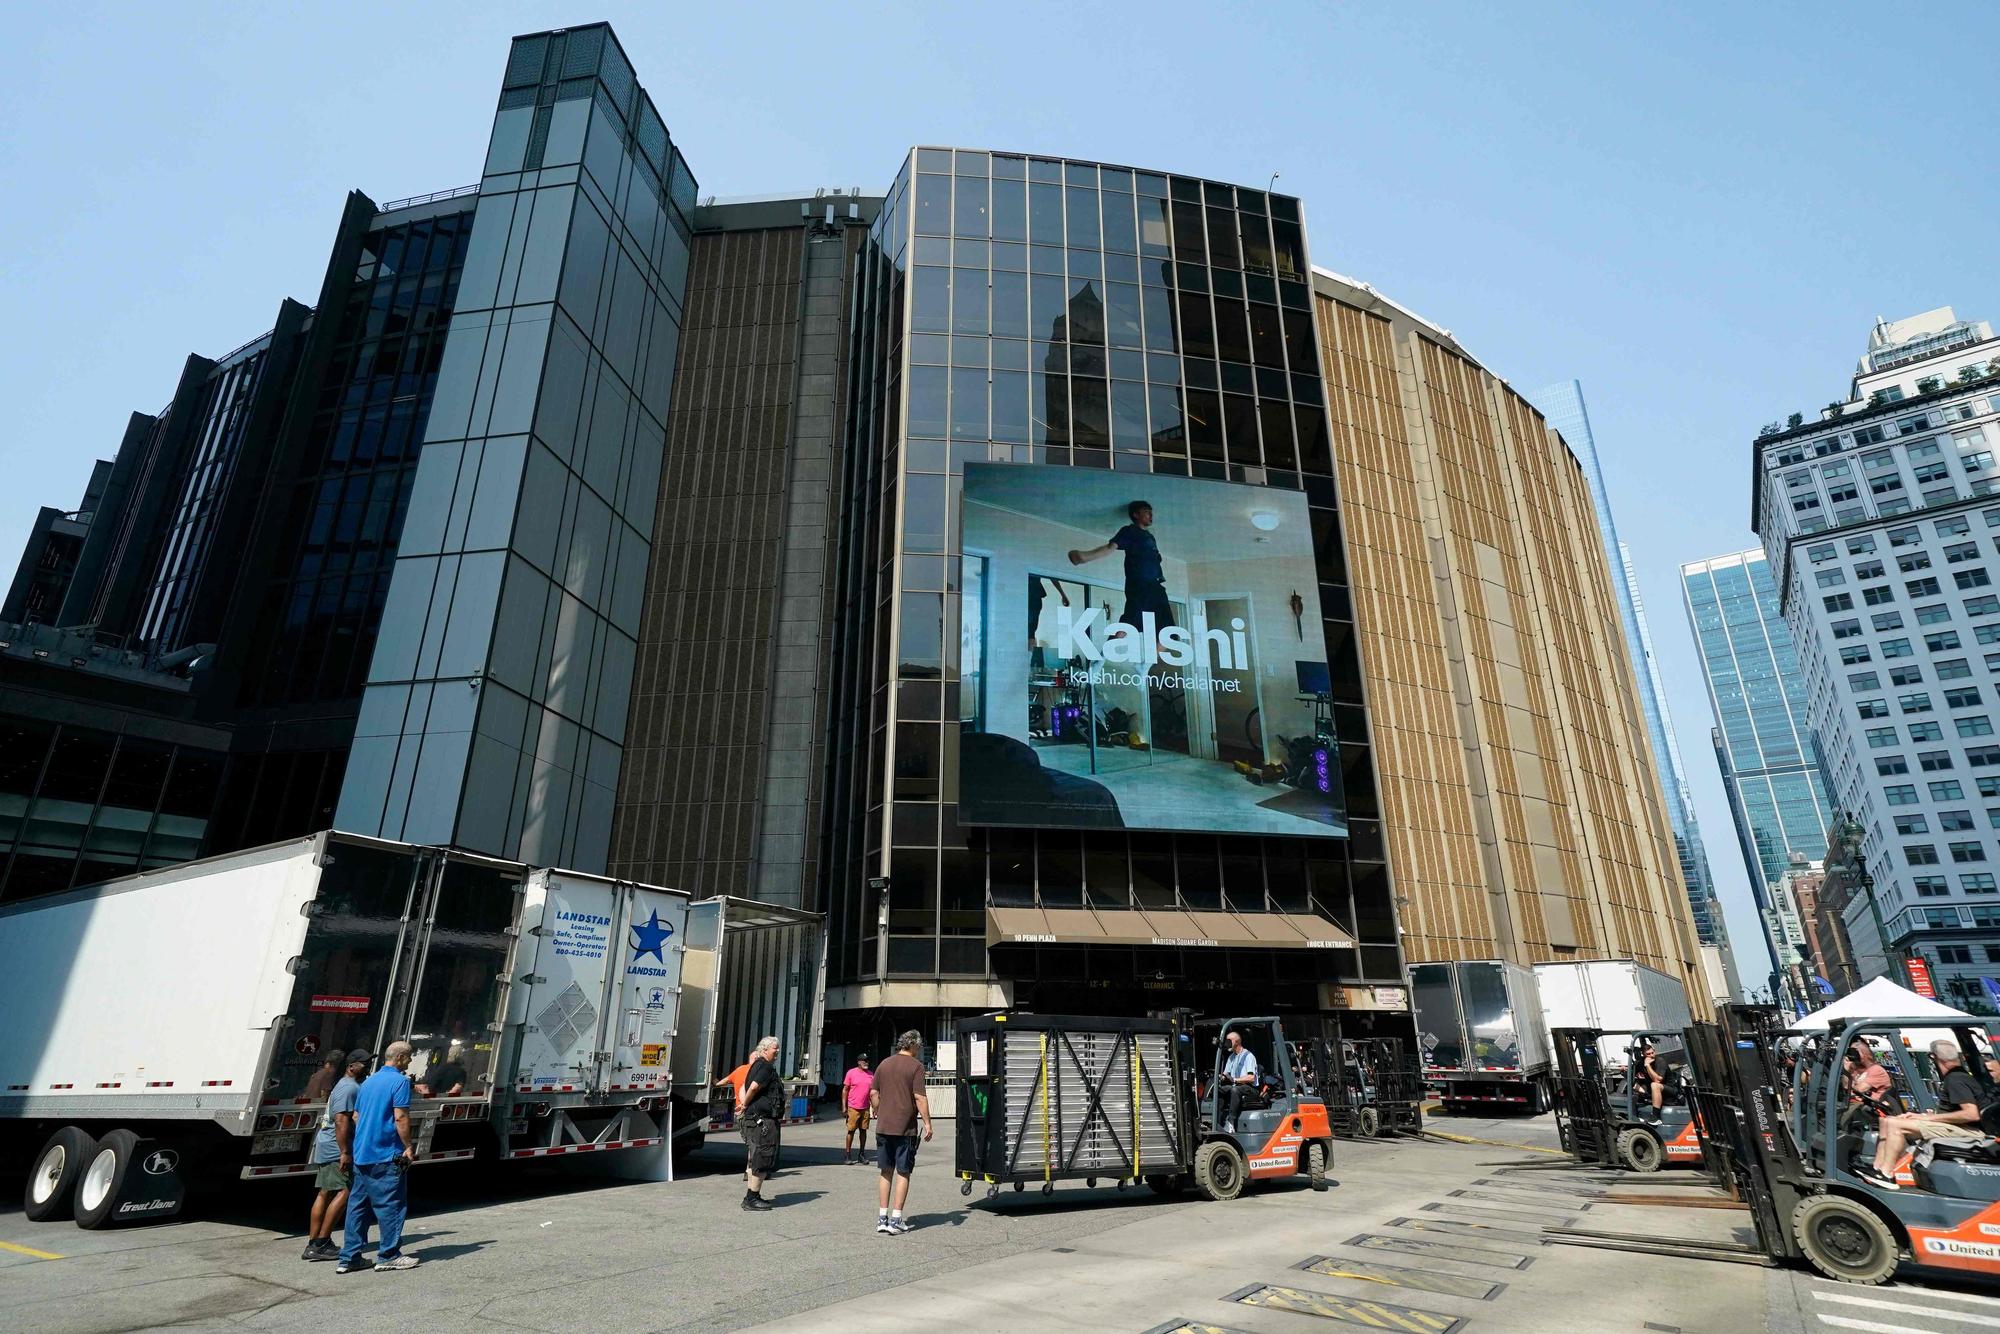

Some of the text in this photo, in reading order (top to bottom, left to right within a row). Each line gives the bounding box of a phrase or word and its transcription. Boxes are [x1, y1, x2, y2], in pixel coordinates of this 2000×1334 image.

[1056, 606, 1249, 671] Kalshi
[1070, 666, 1242, 693] kalshi.com/chalamet
[556, 911, 611, 926] LANDSTAR
[570, 923, 595, 933] Leasing
[556, 930, 606, 942] Safe, Compliant
[1014, 934, 1057, 943] 10 PENN PLAZA
[552, 938, 607, 951] Owner-Operators
[1306, 940, 1353, 949] TRUCK ENTRANCE
[555, 948, 602, 959] 800-435-4010
[627, 965, 667, 977] LANDSTAR
[1143, 981, 1175, 990] CLEARANCE
[631, 1073, 658, 1082] 699144
[1752, 1089, 1770, 1131] TOYOTA
[1258, 1159, 1292, 1168] United Rentals
[119, 1199, 176, 1213] Great Dane
[1949, 1243, 1994, 1257] United
